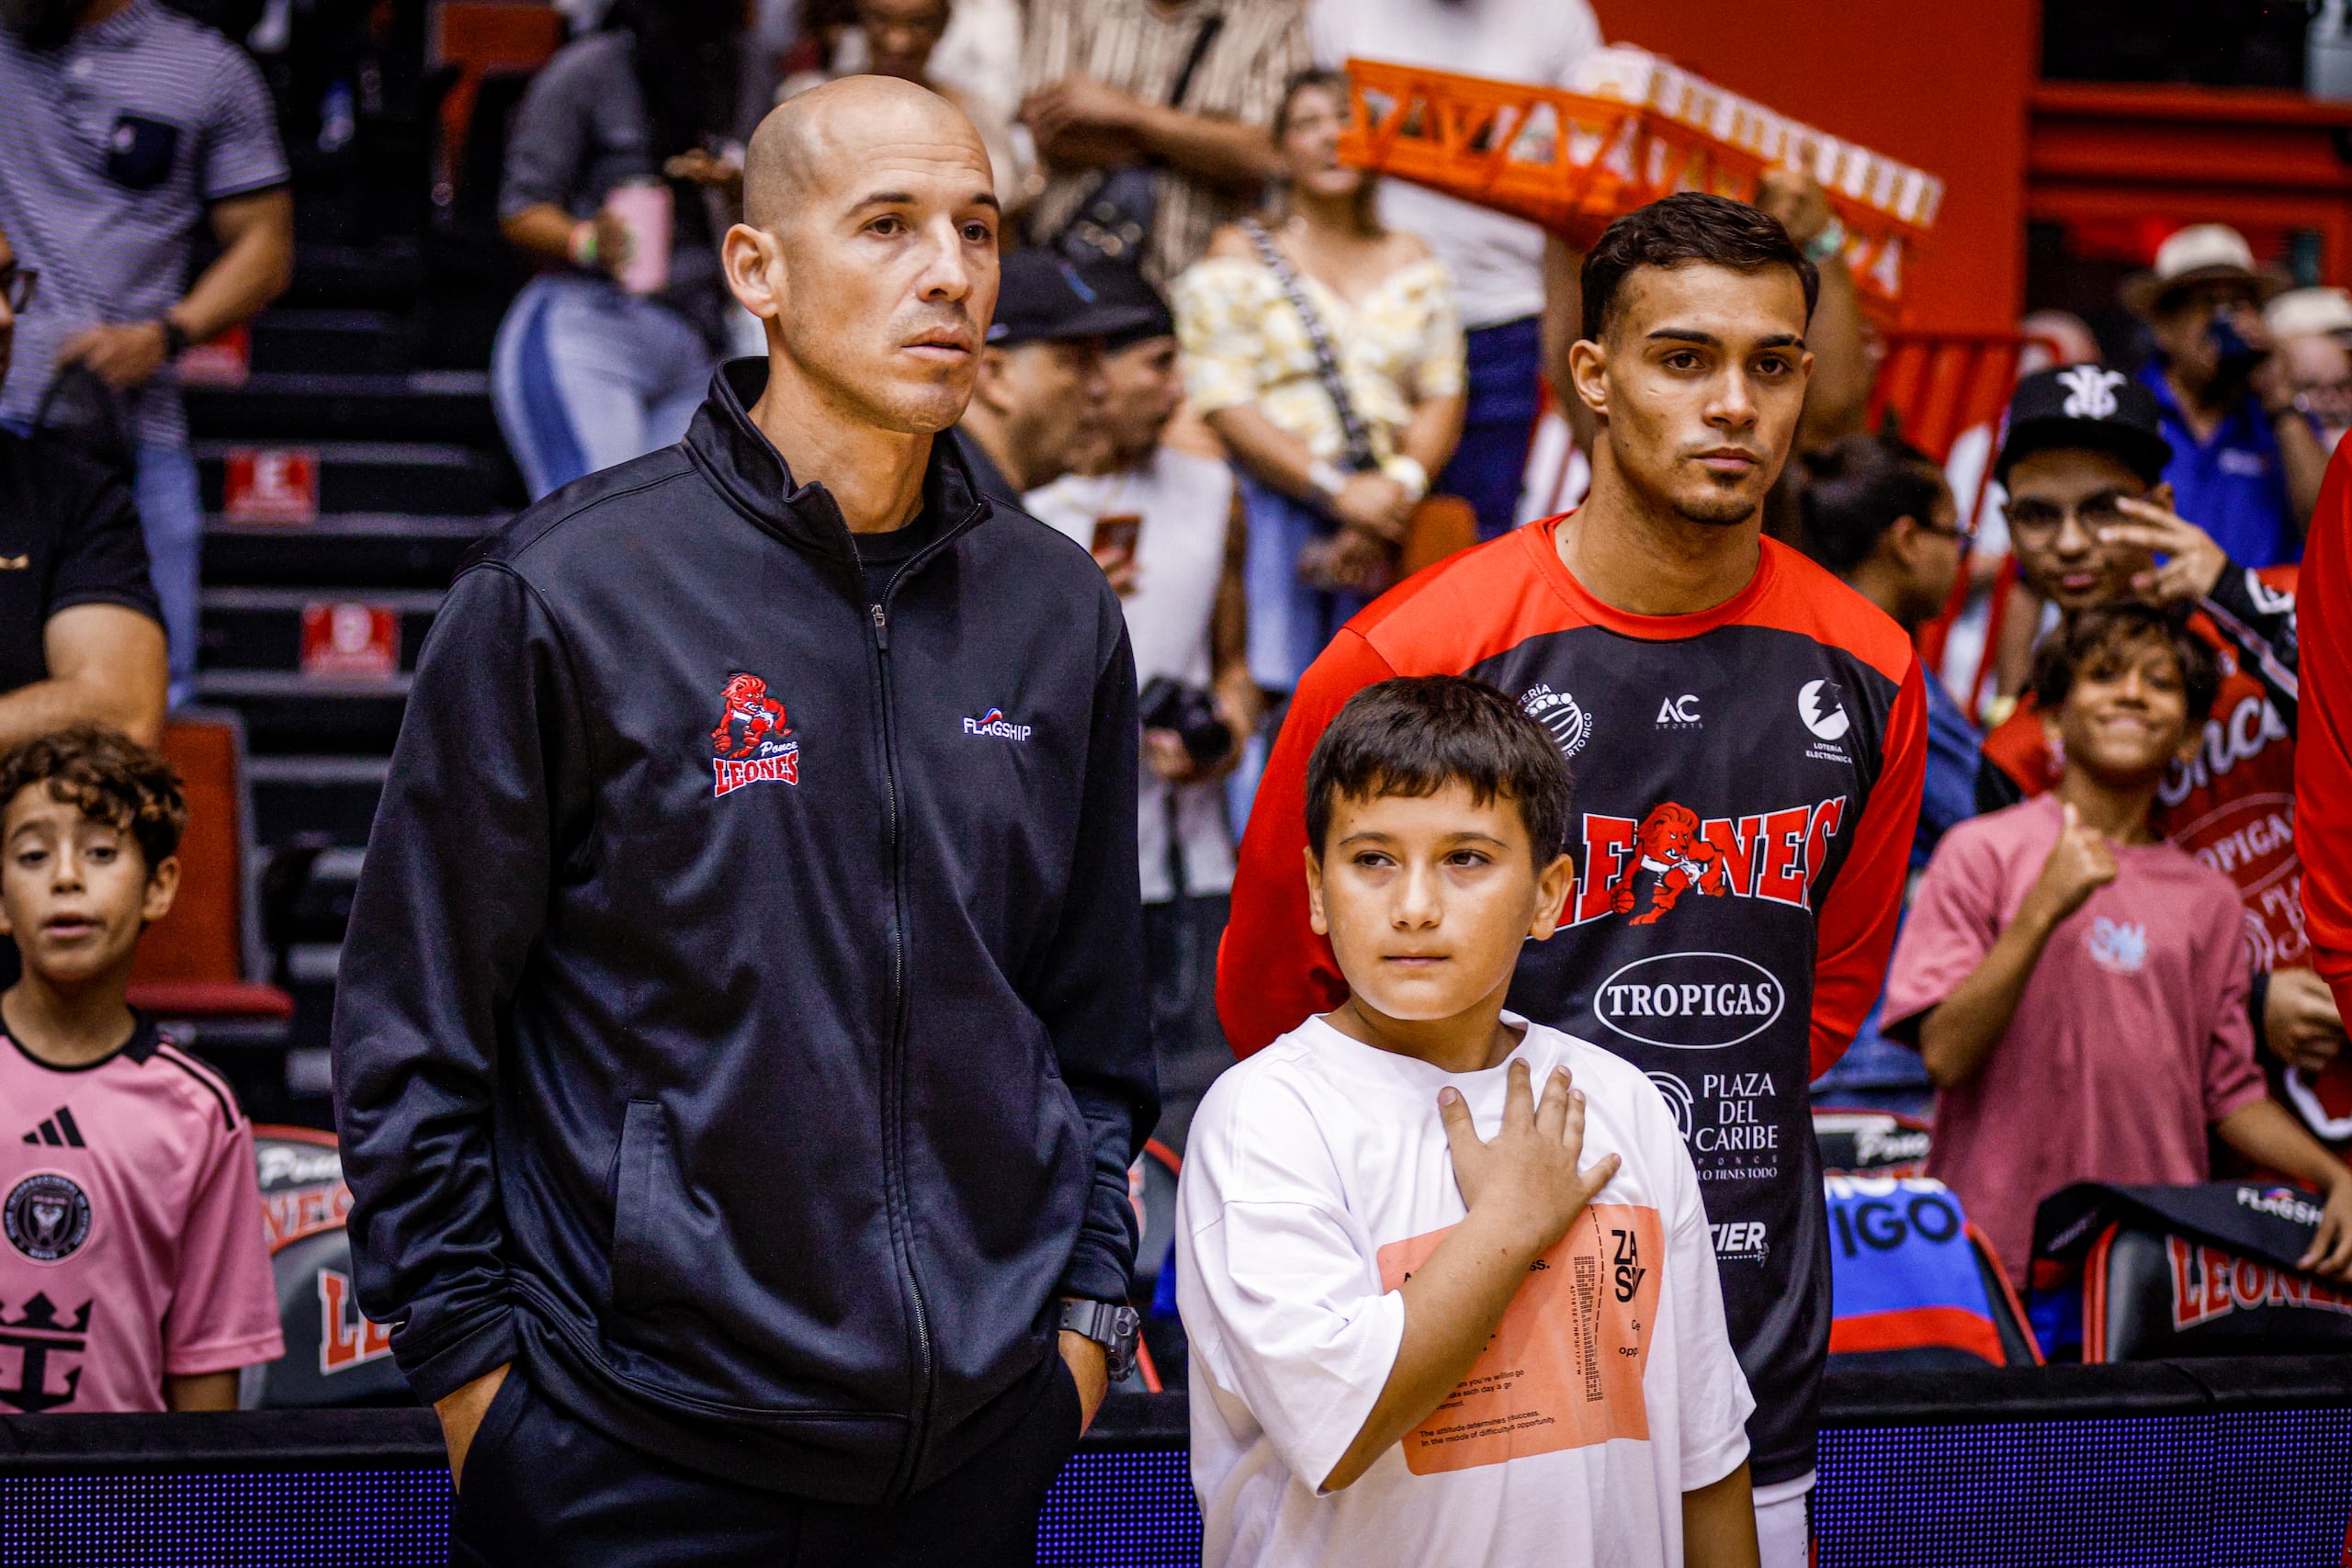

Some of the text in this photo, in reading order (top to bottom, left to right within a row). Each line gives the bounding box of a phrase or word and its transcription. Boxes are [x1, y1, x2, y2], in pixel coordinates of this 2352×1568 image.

[1656, 694, 1701, 723] AC
[963, 716, 1032, 742] FLAGSHIP
[1582, 712, 1593, 739] RICO
[761, 740, 798, 756] Ponce
[713, 750, 798, 798] LEONES
[1608, 982, 1772, 1017] TROPIGAS
[1703, 1073, 1776, 1098] PLAZA
[1719, 1100, 1758, 1124] DEL
[1695, 1125, 1779, 1152] CARIBE
[1698, 1155, 1777, 1166] PONCE
[1747, 1167, 1778, 1179] TODO
[2236, 1187, 2324, 1226] FLAGSH
[1708, 1221, 1767, 1252] IER
[1834, 1196, 1959, 1258] IGO
[1419, 1429, 1435, 1438] The
[1430, 1436, 1444, 1445] the
[1470, 1431, 1478, 1439] of
